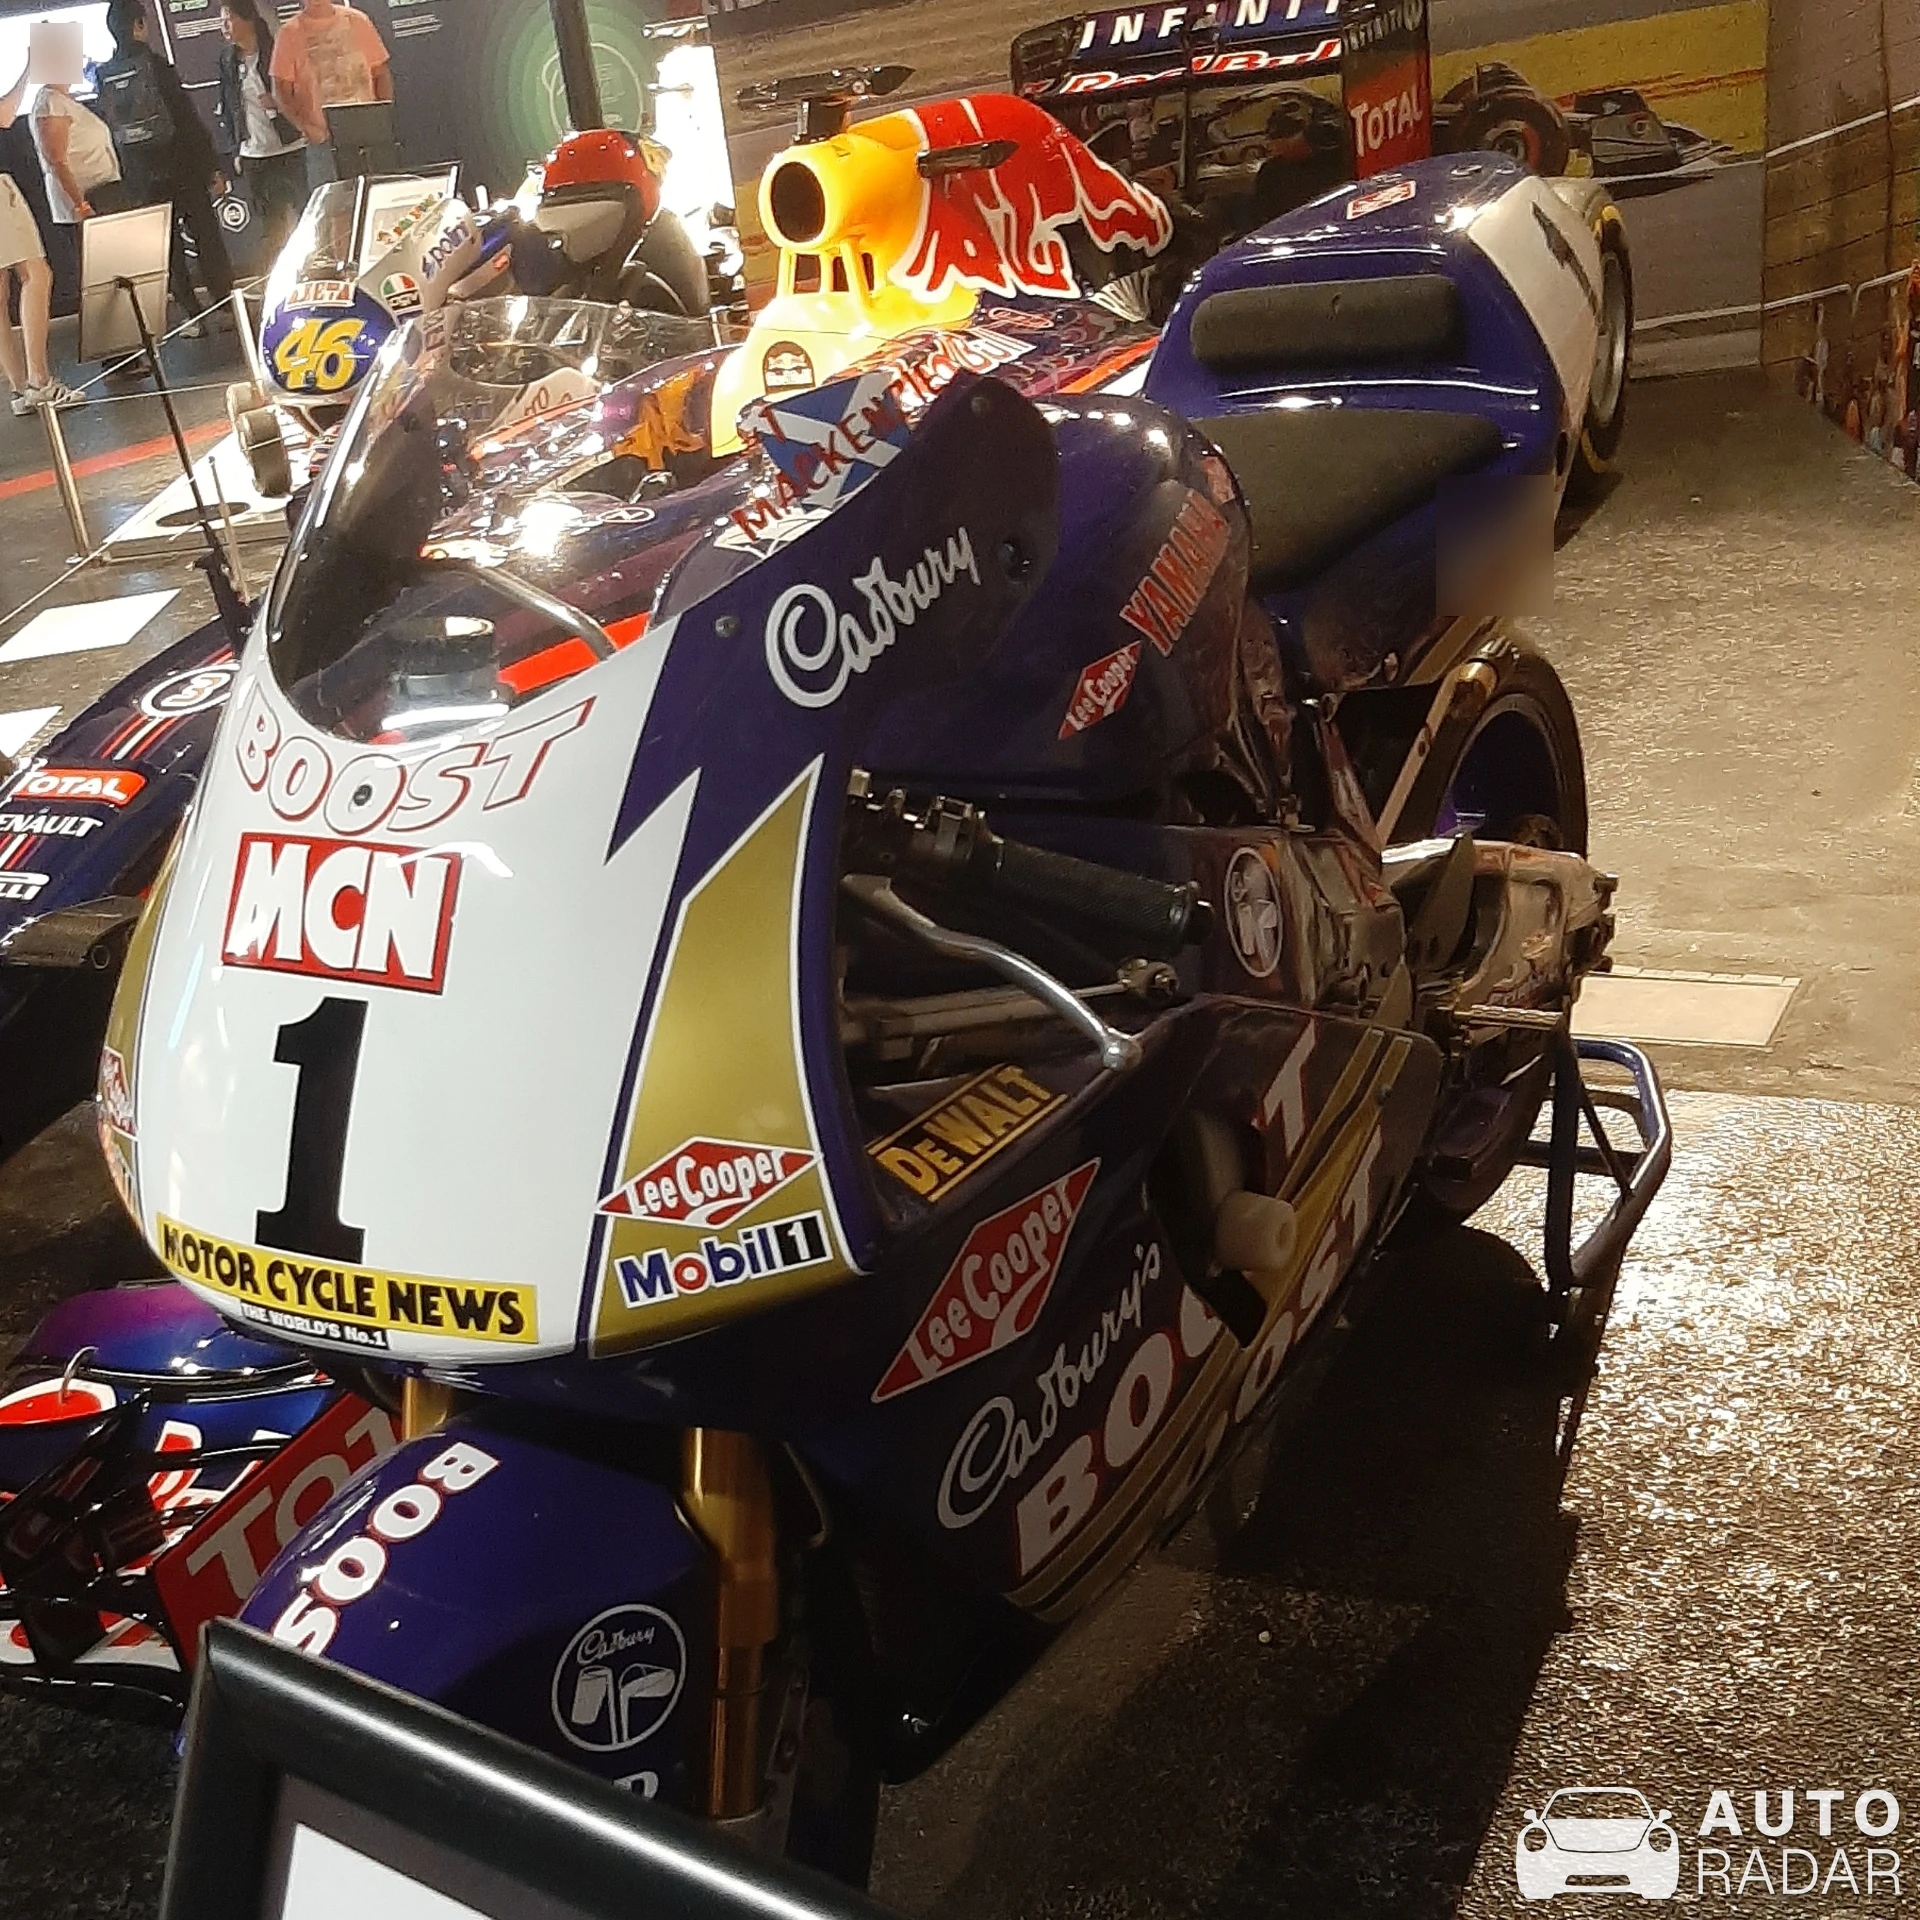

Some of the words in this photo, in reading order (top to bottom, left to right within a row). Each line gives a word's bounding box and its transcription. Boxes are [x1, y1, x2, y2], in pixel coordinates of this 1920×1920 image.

[1350, 95, 1423, 157] TOTAL
[275, 317, 366, 391] 46
[766, 527, 981, 708] Cadbury
[14, 768, 128, 801] TOTAL
[235, 680, 597, 836] BOOST
[0, 813, 103, 838] ENAULT
[224, 840, 451, 980] MCN
[256, 996, 369, 1263] 1
[163, 1222, 262, 1295] MOTOR
[266, 1260, 378, 1318] CYCLE
[386, 1280, 526, 1336] NEWS
[241, 1303, 269, 1323] THE
[268, 1310, 341, 1339] WORLD'S
[344, 1325, 387, 1347] No.1
[619, 1227, 781, 1303] Mobil
[937, 1242, 1161, 1529] Cadbury's
[186, 1406, 392, 1601] TOT
[272, 1441, 500, 1657] BOOS
